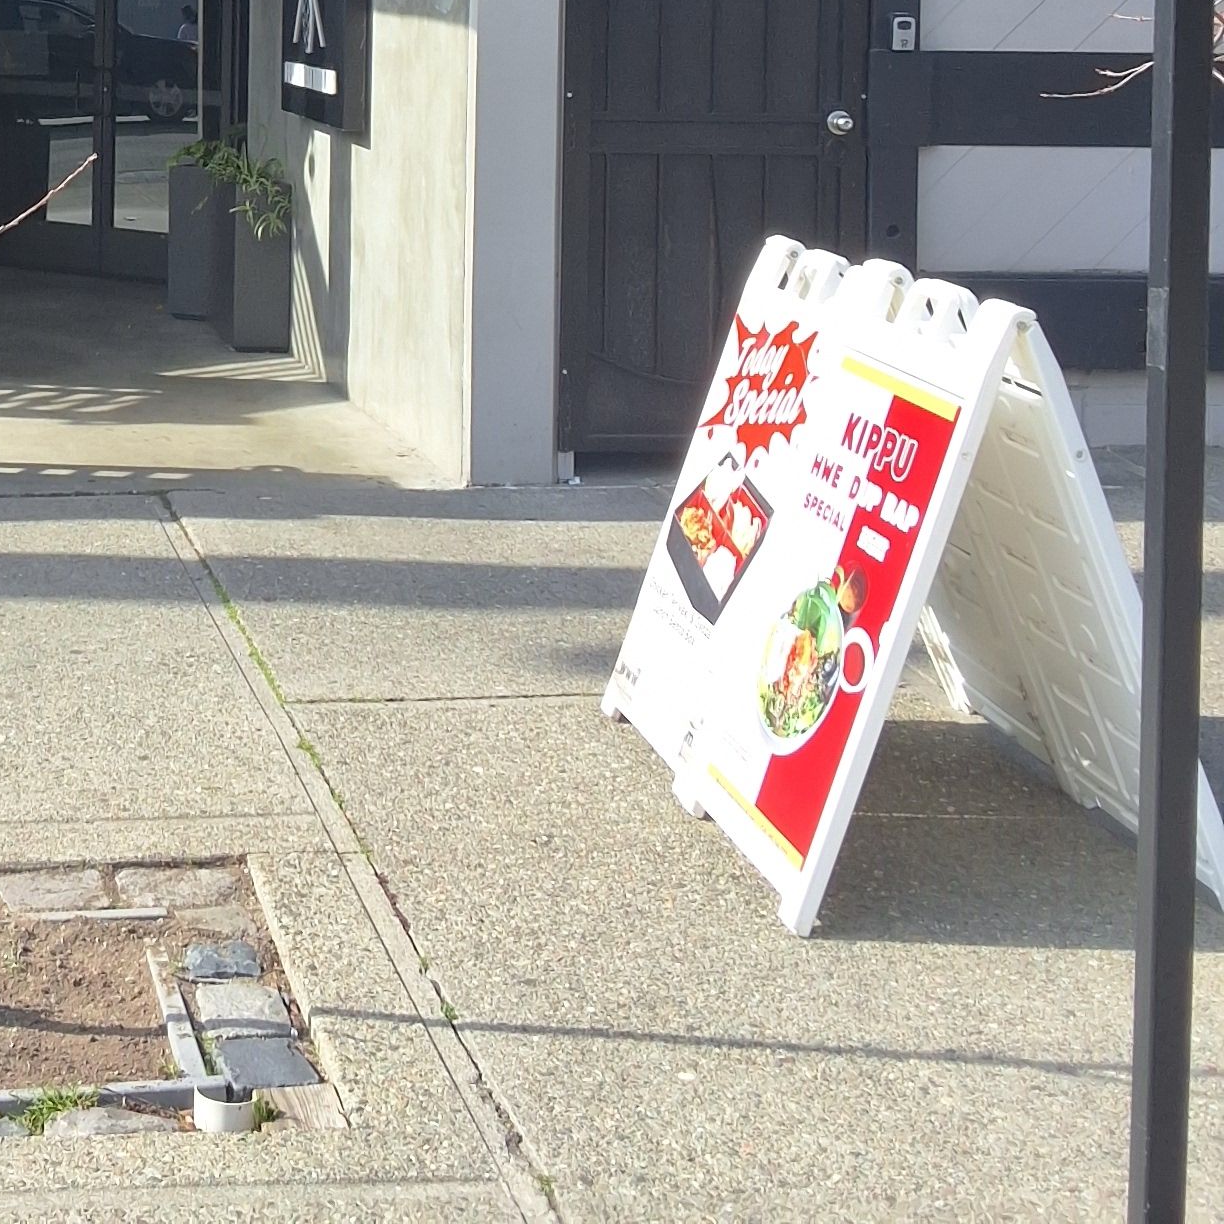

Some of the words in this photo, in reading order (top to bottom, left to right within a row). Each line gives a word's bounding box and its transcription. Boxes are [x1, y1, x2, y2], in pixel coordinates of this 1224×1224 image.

[737, 337, 790, 390] Today
[723, 373, 805, 427] Special
[810, 453, 844, 489] HWE
[840, 412, 918, 482] KIPPU
[803, 492, 845, 533] SPECIAL
